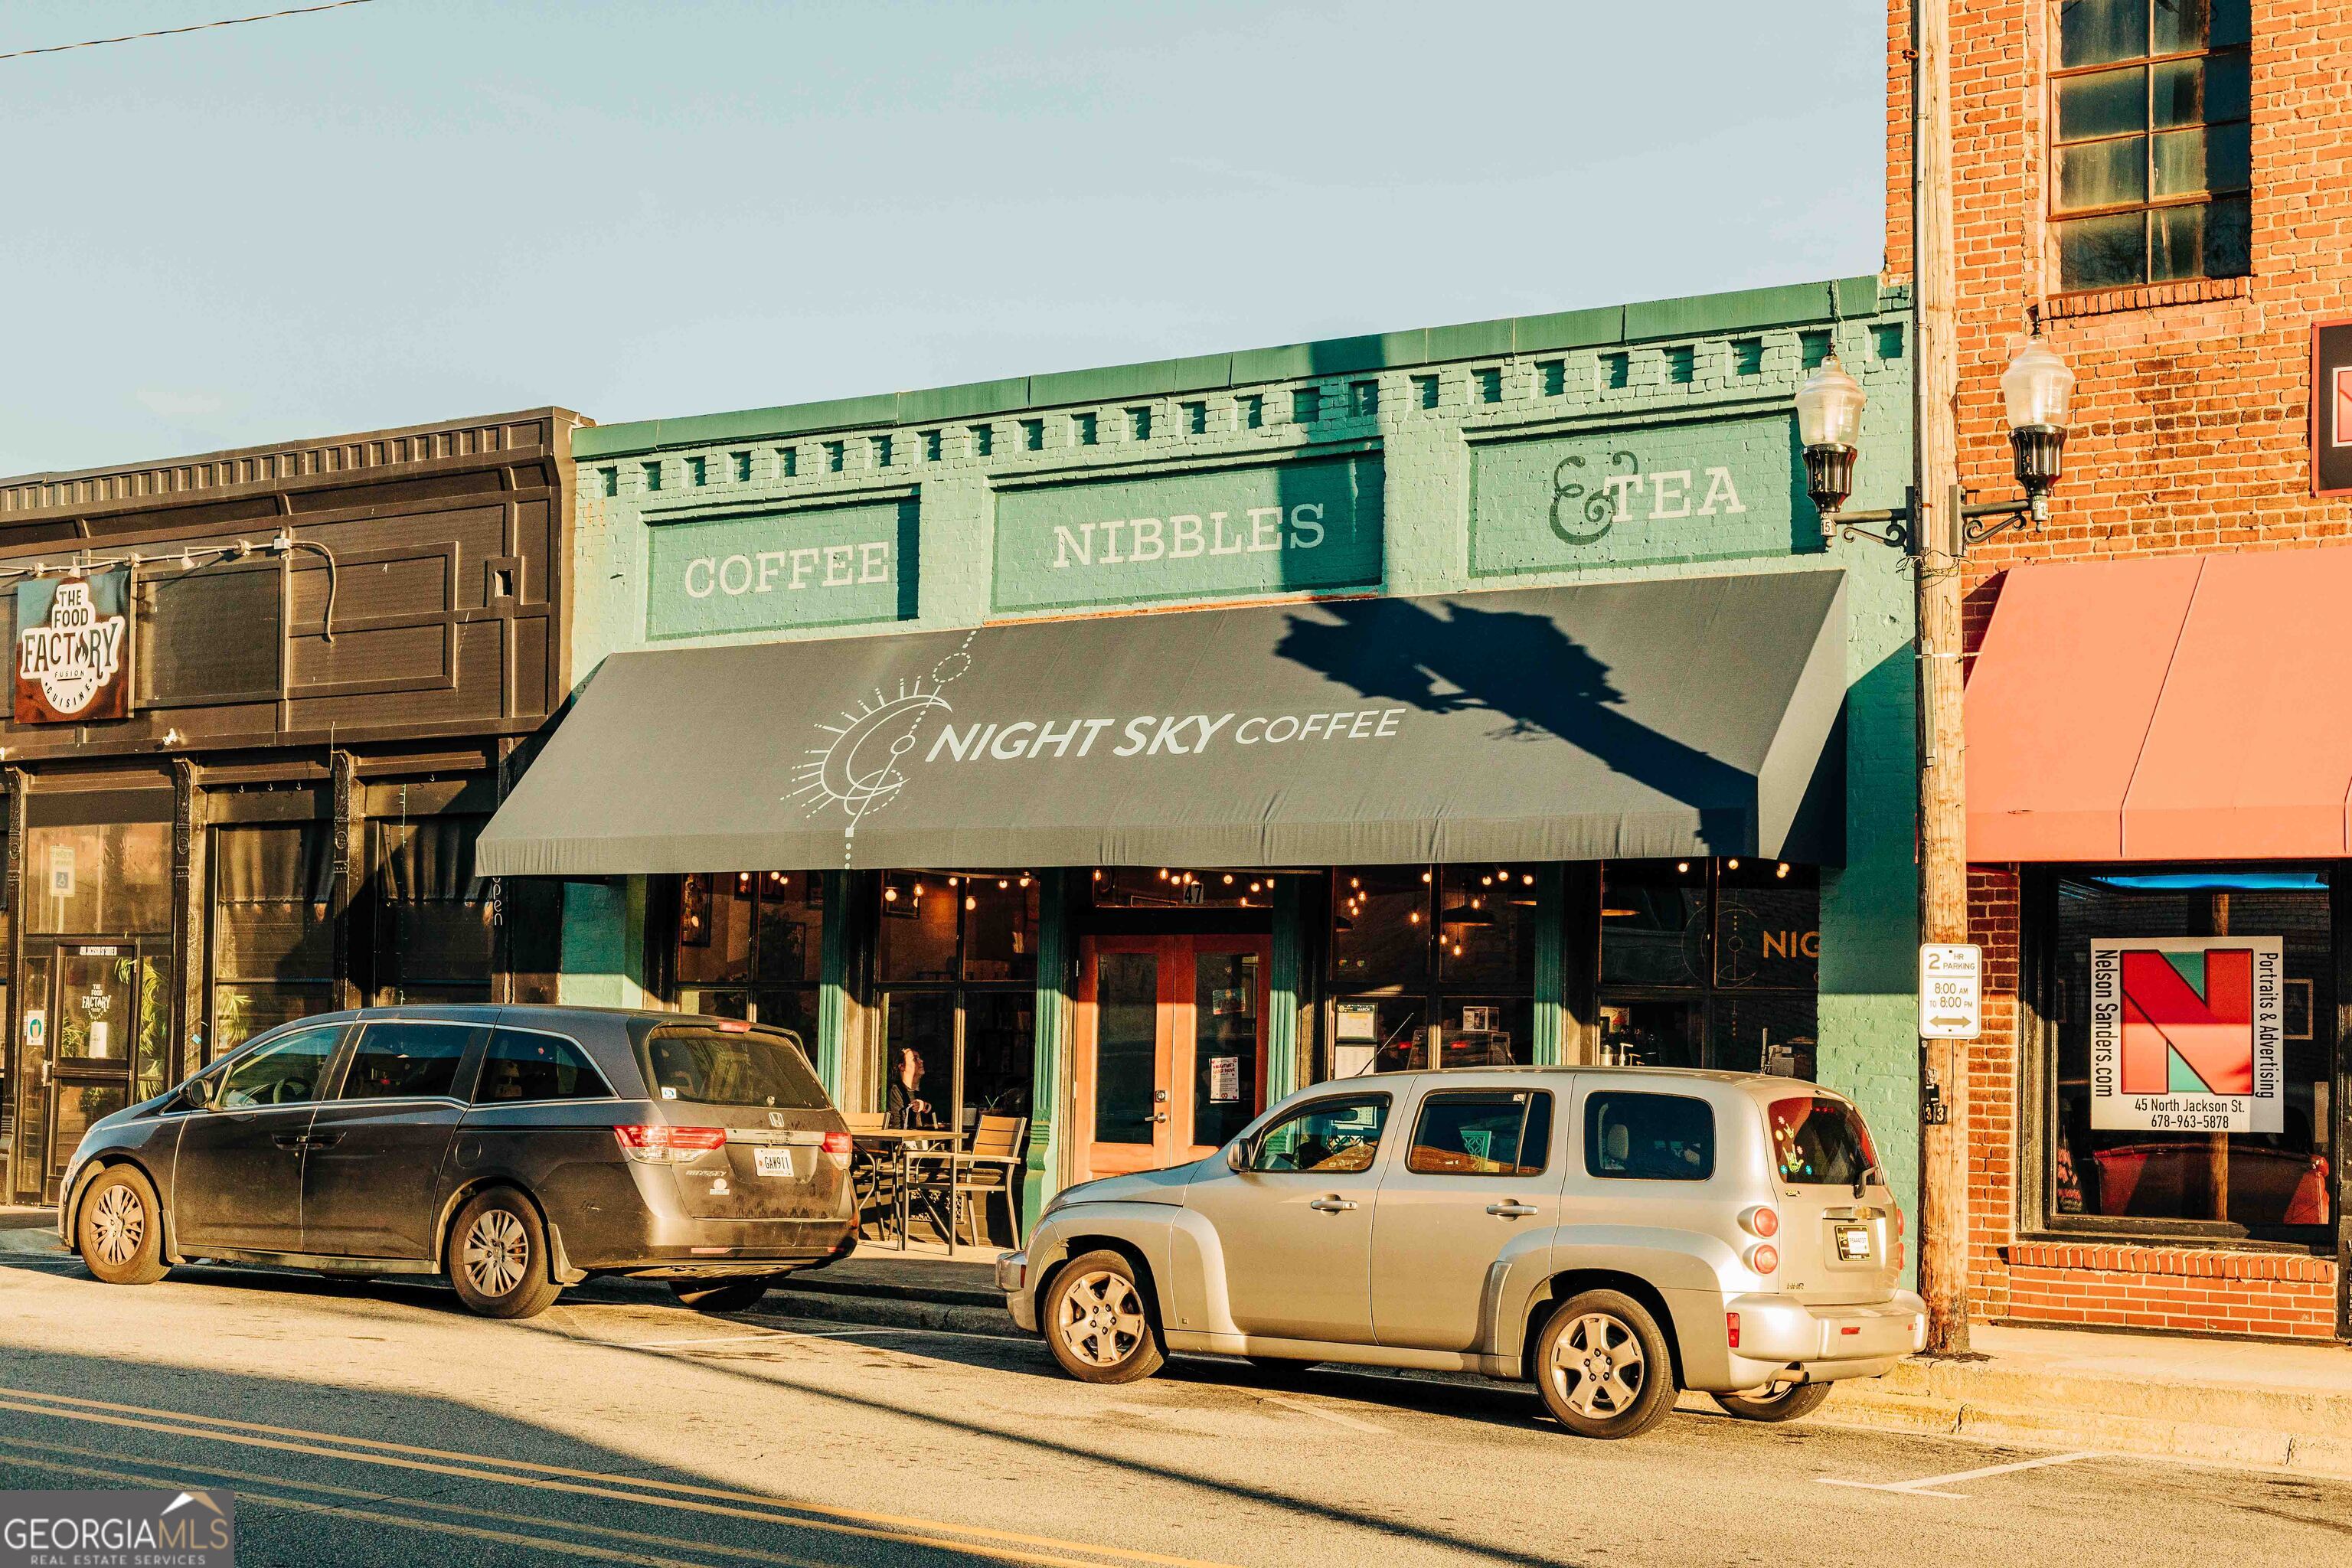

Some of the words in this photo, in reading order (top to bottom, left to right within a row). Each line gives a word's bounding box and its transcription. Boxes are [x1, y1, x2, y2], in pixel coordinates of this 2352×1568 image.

[1550, 450, 1638, 546] &
[1603, 466, 1746, 523] TEA
[1053, 503, 1325, 569] NIBBLES
[684, 541, 890, 599] COFFEE
[59, 589, 82, 606] THE
[54, 608, 89, 628] FOOD
[47, 683, 90, 707] CUISINE
[925, 718, 1114, 762] NIGHT
[1112, 713, 1236, 756] SKY
[1235, 708, 1406, 744] COFFEE
[1184, 884, 1203, 903] 47
[1929, 953, 1940, 969] 2
[2095, 949, 2118, 998] Nelson
[2259, 952, 2278, 1008] Portraits
[1935, 982, 1956, 995] 8:00
[1939, 996, 1962, 1008] 8:00
[2259, 1013, 2277, 1021] &
[2095, 1003, 2118, 1098] Sanders.com
[2256, 1025, 2279, 1099] Advertising
[2135, 1099, 2148, 1112] 45
[2151, 1098, 2180, 1112] North
[2183, 1098, 2227, 1113] Jackson
[2231, 1099, 2245, 1113] St.
[2151, 1115, 2229, 1129] 678-963-5878
